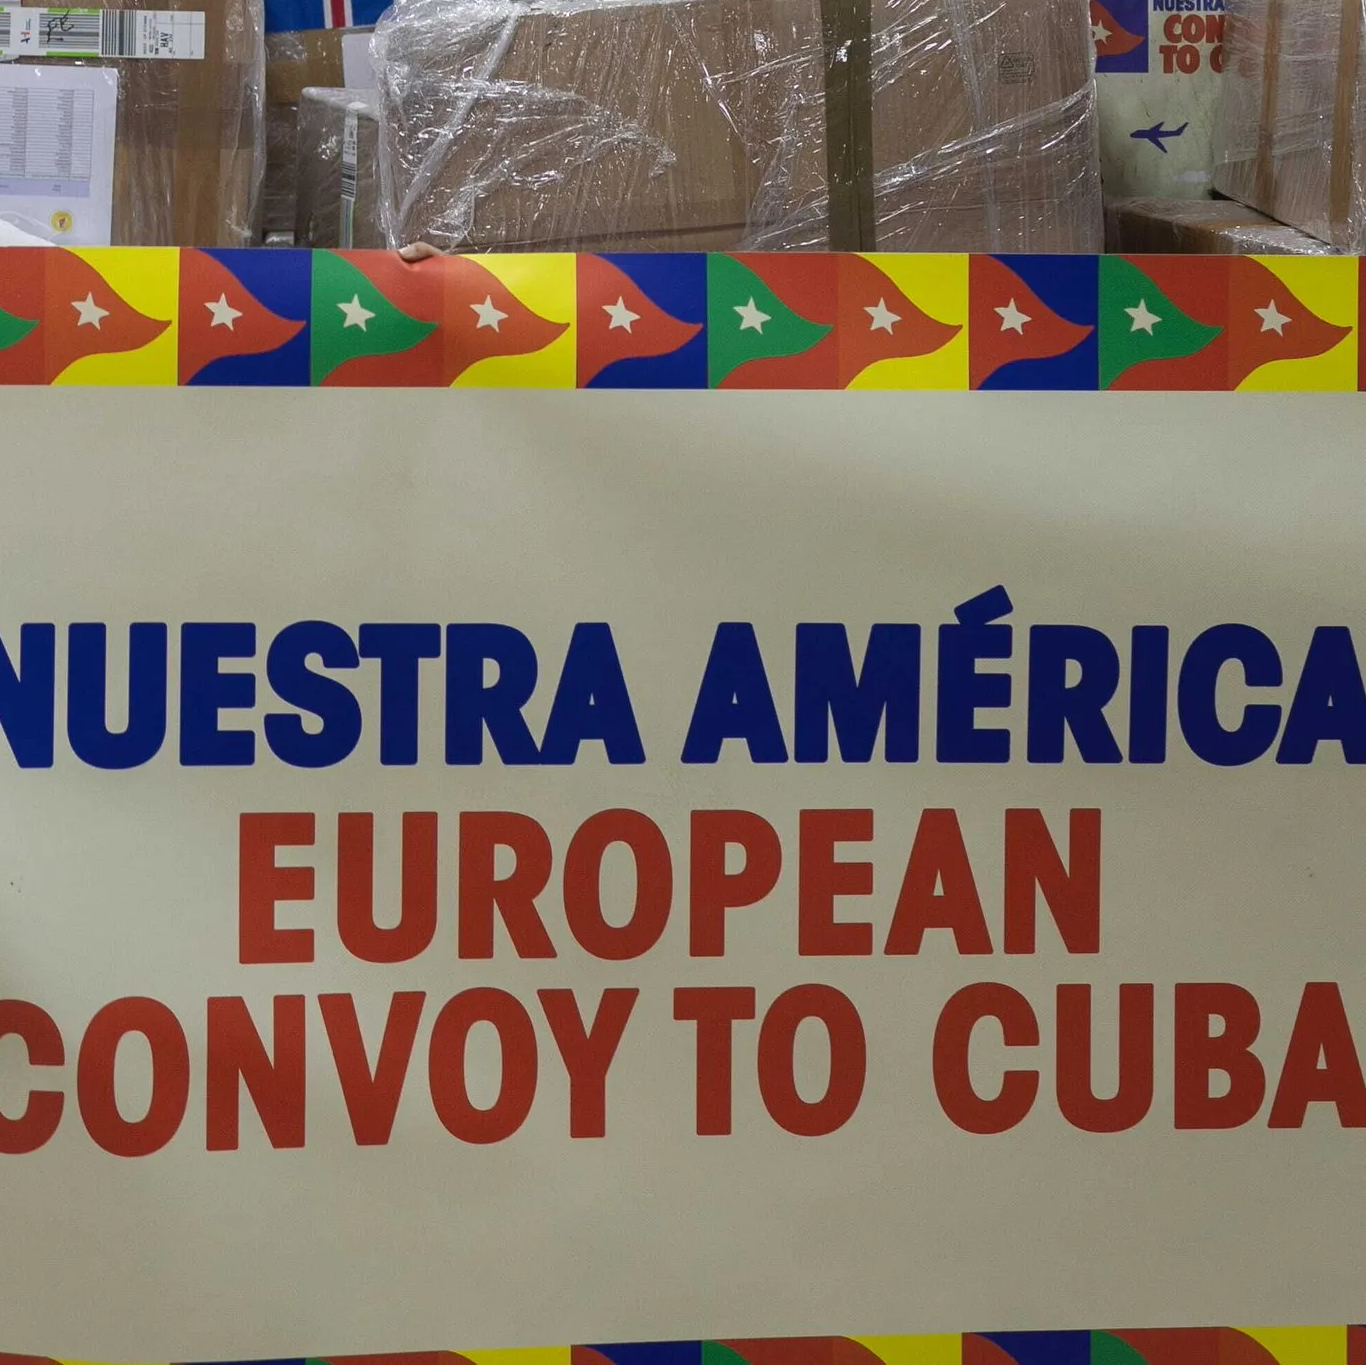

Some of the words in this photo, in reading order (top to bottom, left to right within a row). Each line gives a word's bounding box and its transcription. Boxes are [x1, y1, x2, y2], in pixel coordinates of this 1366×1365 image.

[160, 32, 169, 48] HAV
[1163, 14, 1226, 44] CON
[1159, 44, 1201, 74] TO
[238, 807, 1102, 965] EUROPEAN
[672, 982, 867, 1136] TO
